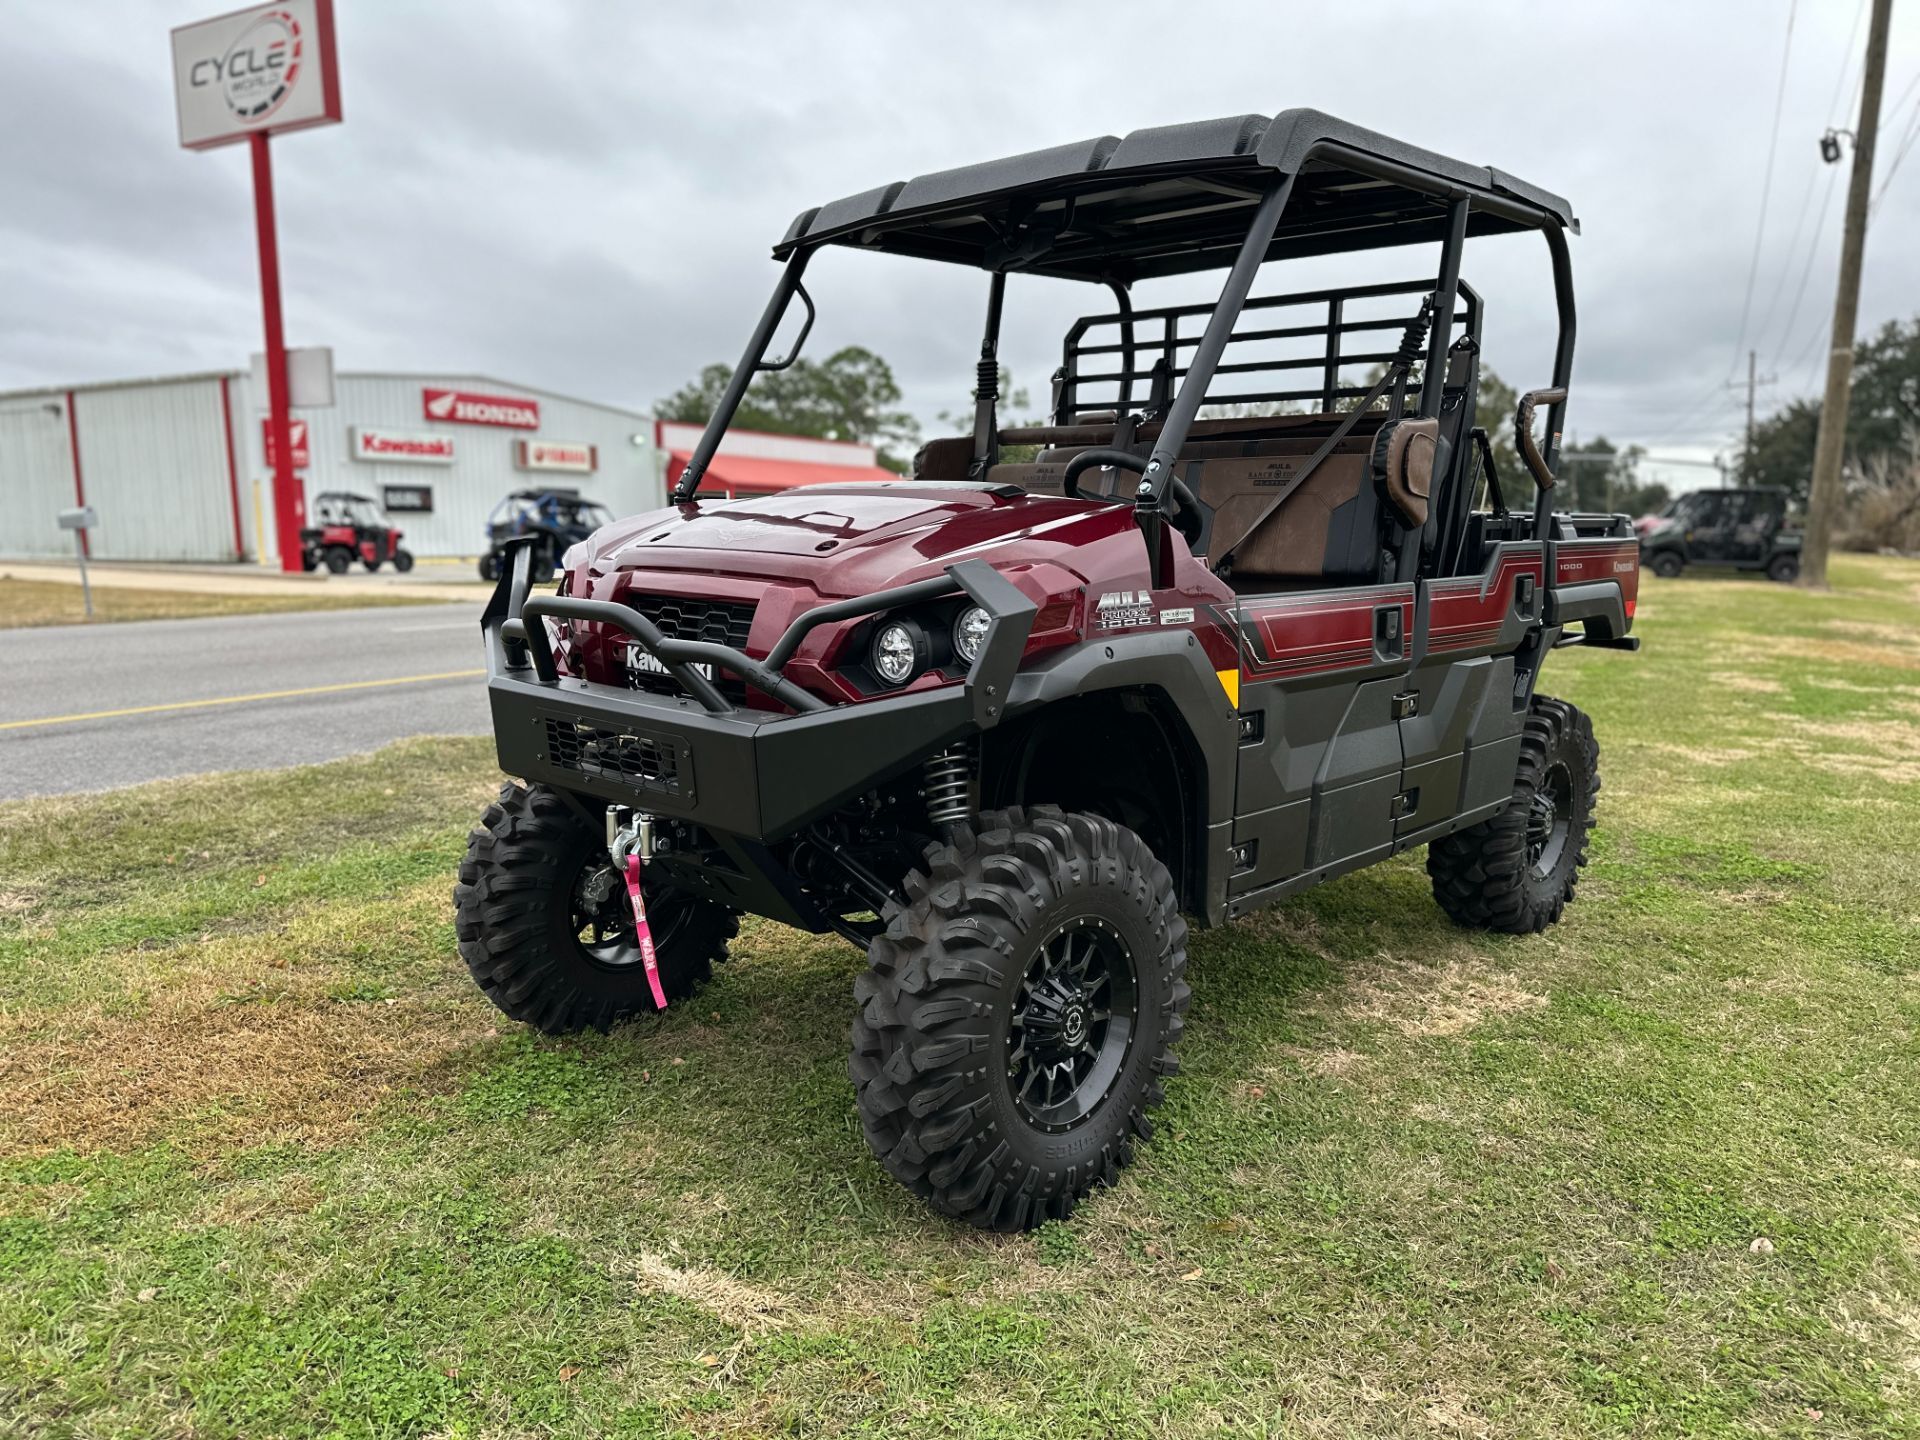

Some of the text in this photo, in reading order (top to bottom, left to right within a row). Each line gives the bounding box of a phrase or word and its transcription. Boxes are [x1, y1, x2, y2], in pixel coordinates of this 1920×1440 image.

[190, 40, 286, 87] CYCLE
[455, 400, 538, 427] HONDA
[363, 433, 453, 456] Kawasaki
[1560, 563, 1583, 571] 1000
[1095, 590, 1155, 613] MULE
[641, 935, 656, 971] WARN
